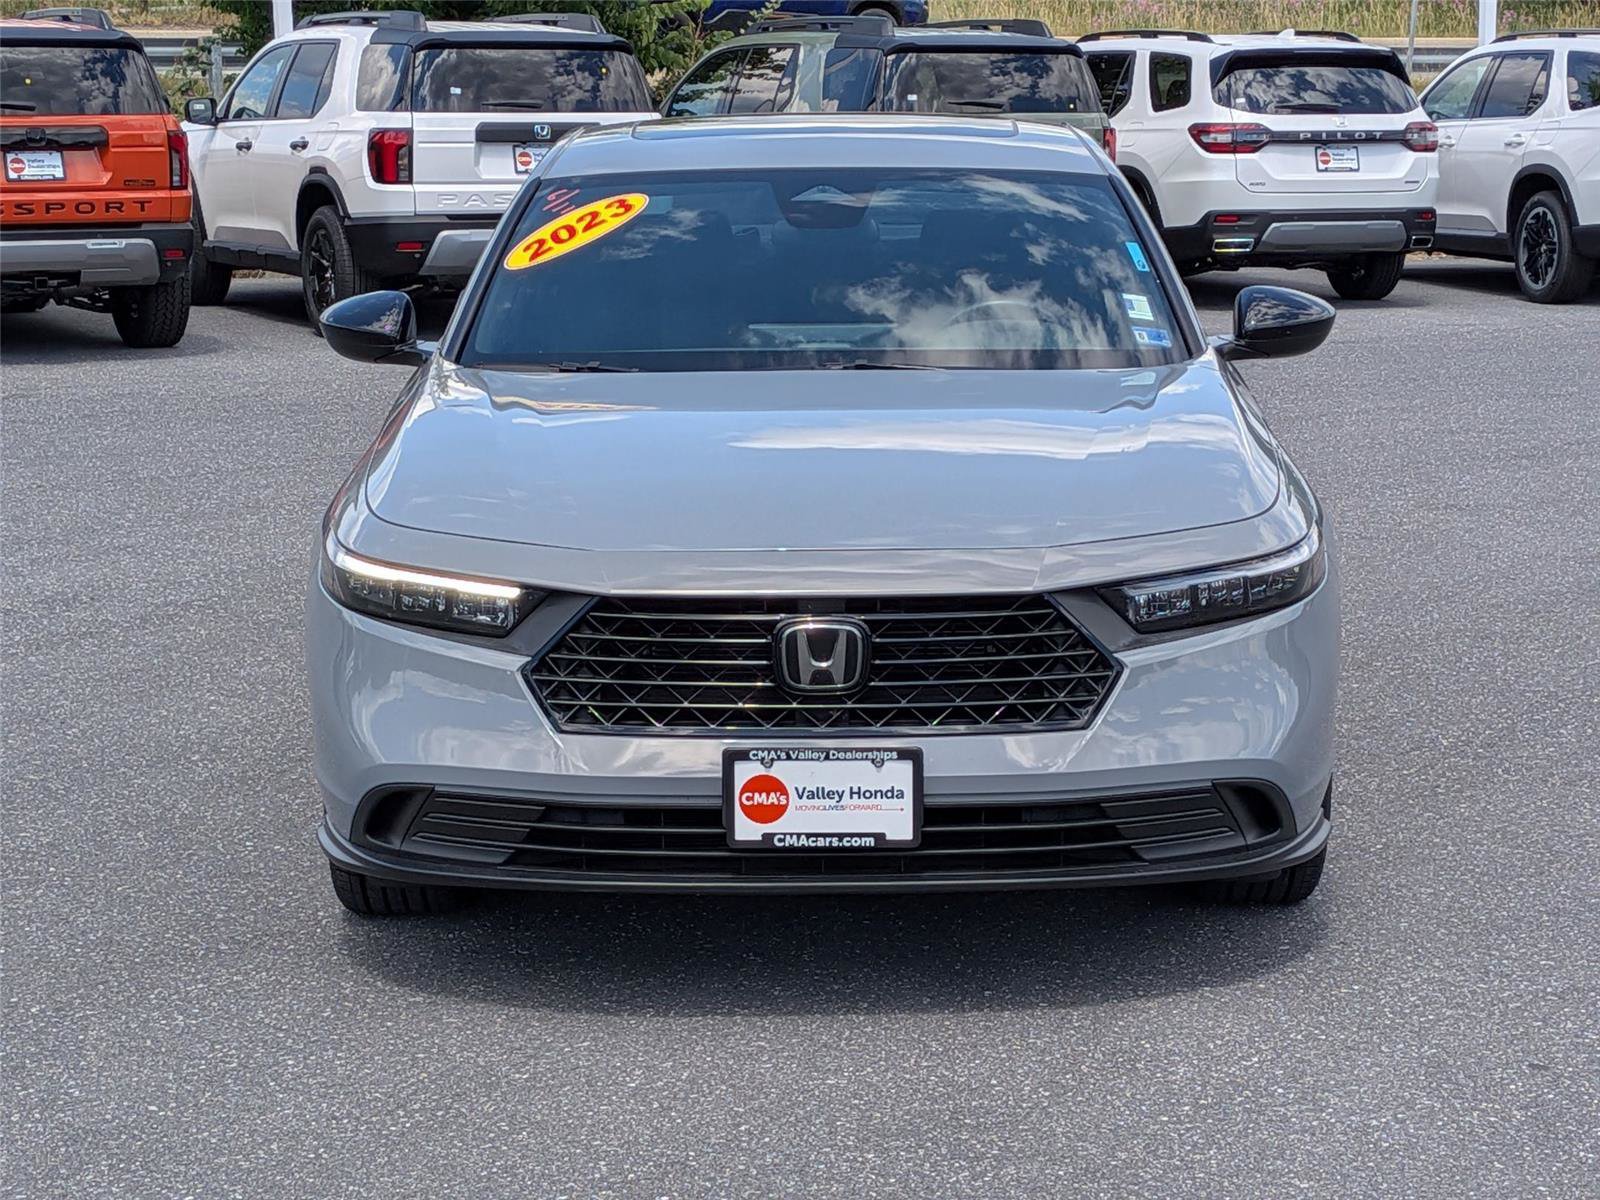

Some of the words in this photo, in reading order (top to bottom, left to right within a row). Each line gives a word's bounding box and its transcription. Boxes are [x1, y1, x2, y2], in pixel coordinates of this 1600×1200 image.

[1300, 132, 1383, 140] PILOT
[0, 200, 152, 215] SPORT
[523, 198, 636, 262] 2023
[750, 750, 787, 760] CMA's
[789, 750, 826, 762] Valley
[829, 750, 898, 761] Dealerships
[741, 791, 788, 806] CMA's
[794, 786, 845, 803] Valley
[849, 786, 905, 800] Honda
[773, 834, 875, 847] CMAcars.com
